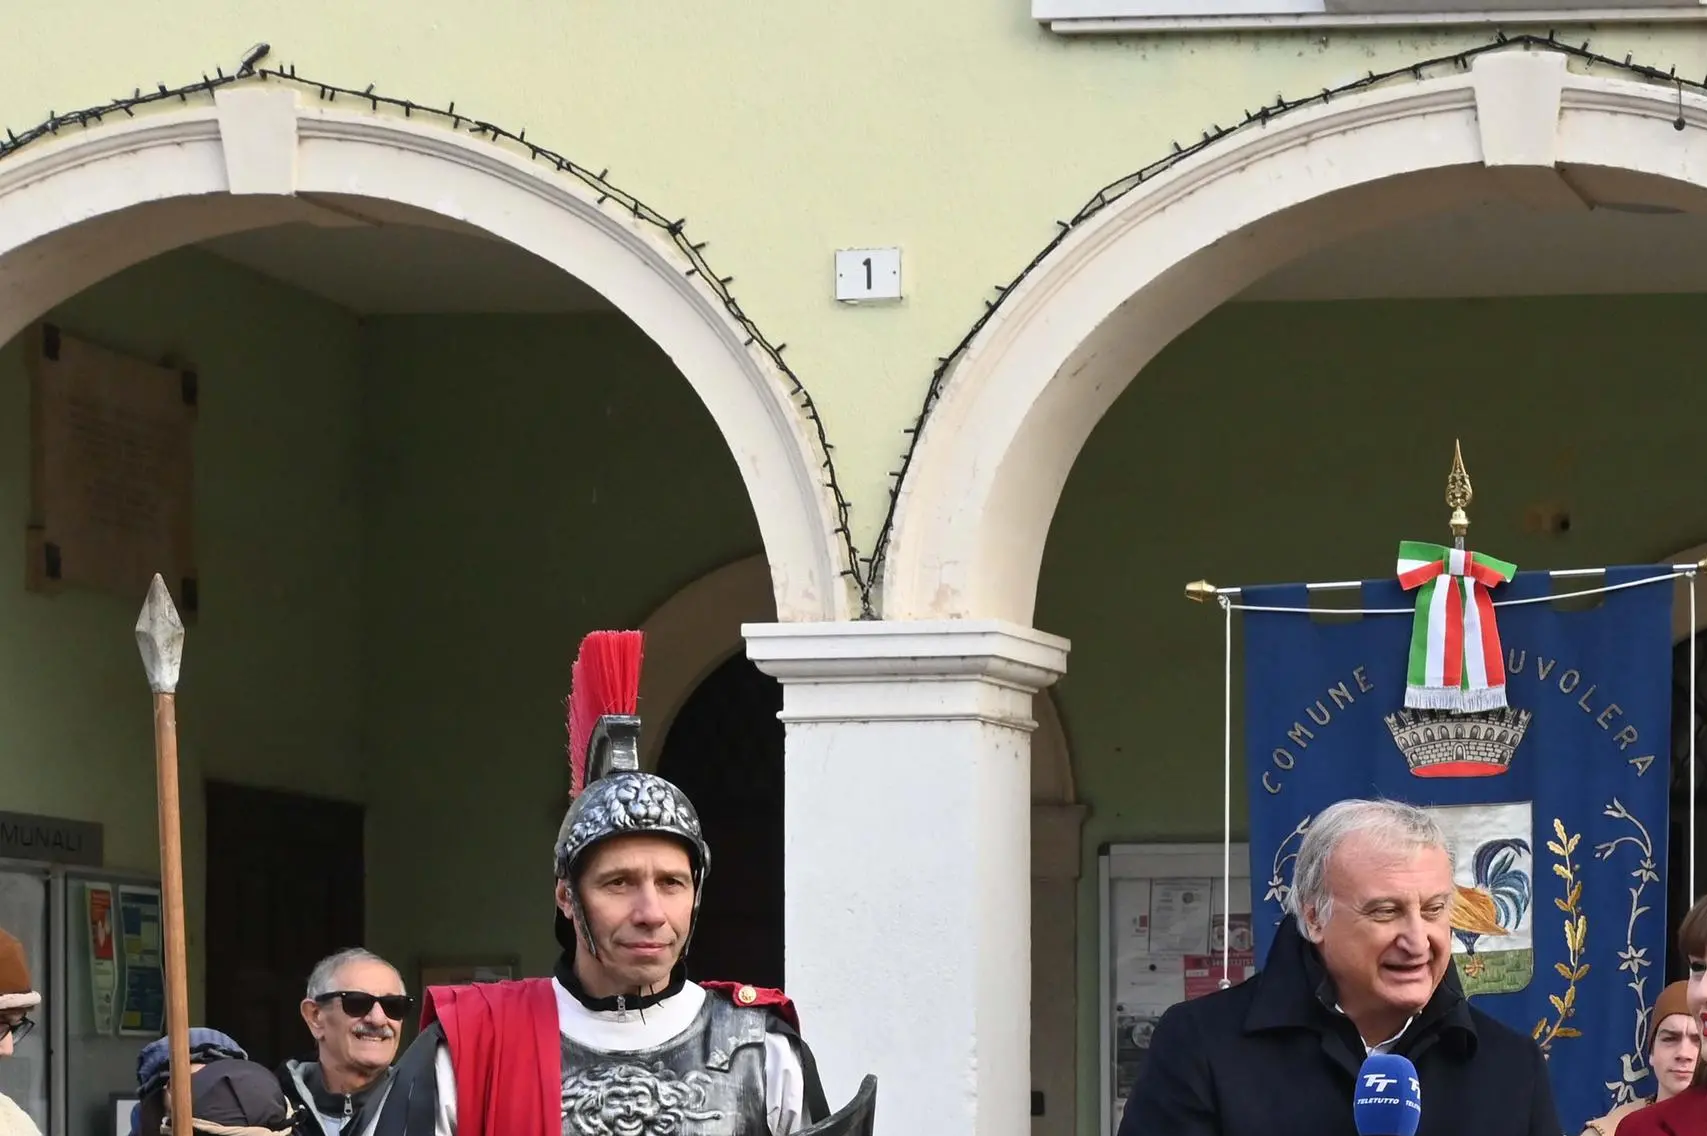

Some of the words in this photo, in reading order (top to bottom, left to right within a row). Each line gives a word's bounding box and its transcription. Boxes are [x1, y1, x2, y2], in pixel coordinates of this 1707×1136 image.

[862, 257, 872, 290] 1
[1262, 665, 1374, 795] COMUNE
[1508, 648, 1656, 778] UVOLERA
[1357, 1097, 1400, 1105] TELETUTTO
